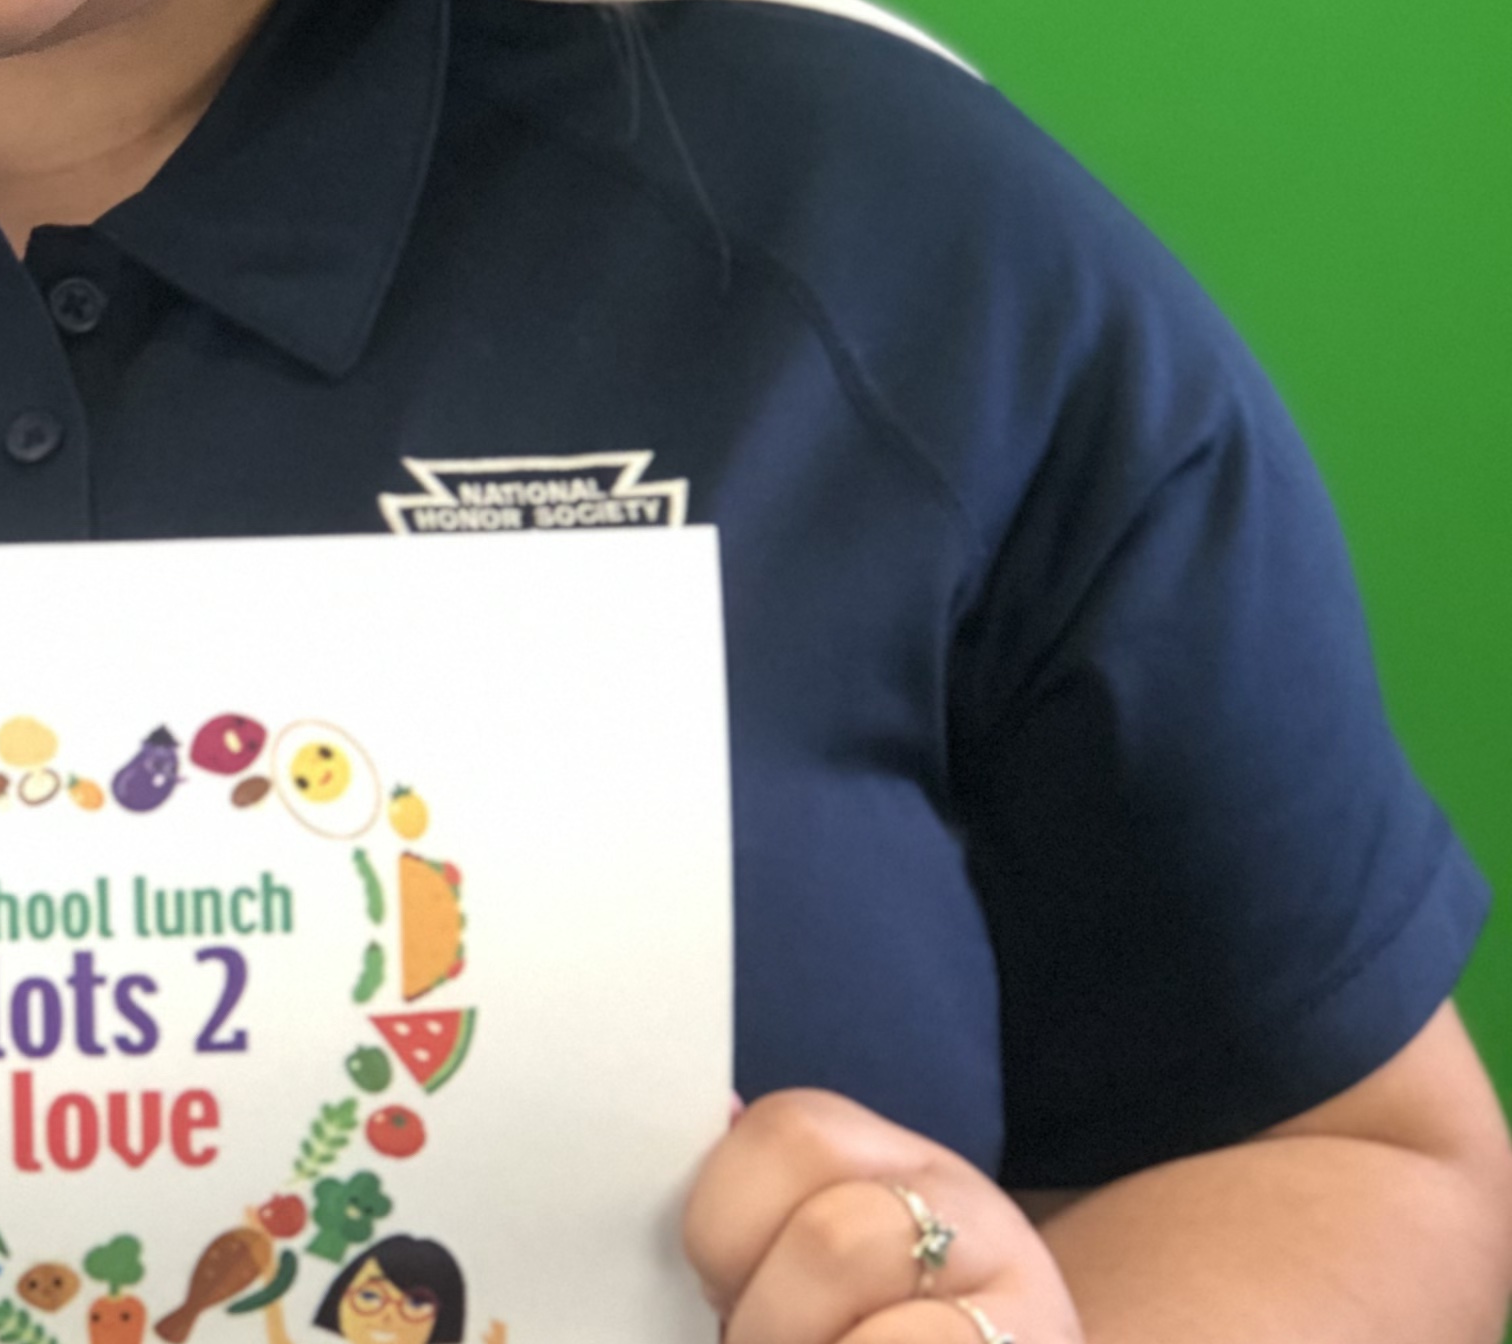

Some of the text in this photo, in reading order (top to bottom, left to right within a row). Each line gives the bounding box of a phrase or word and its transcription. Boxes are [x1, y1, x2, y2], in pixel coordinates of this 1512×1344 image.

[413, 499, 661, 532] HONOR SOCIETY
[457, 478, 607, 507] NATIONAL
[133, 871, 294, 939] lunch
[193, 946, 249, 1054] 2
[12, 1069, 221, 1174] love
